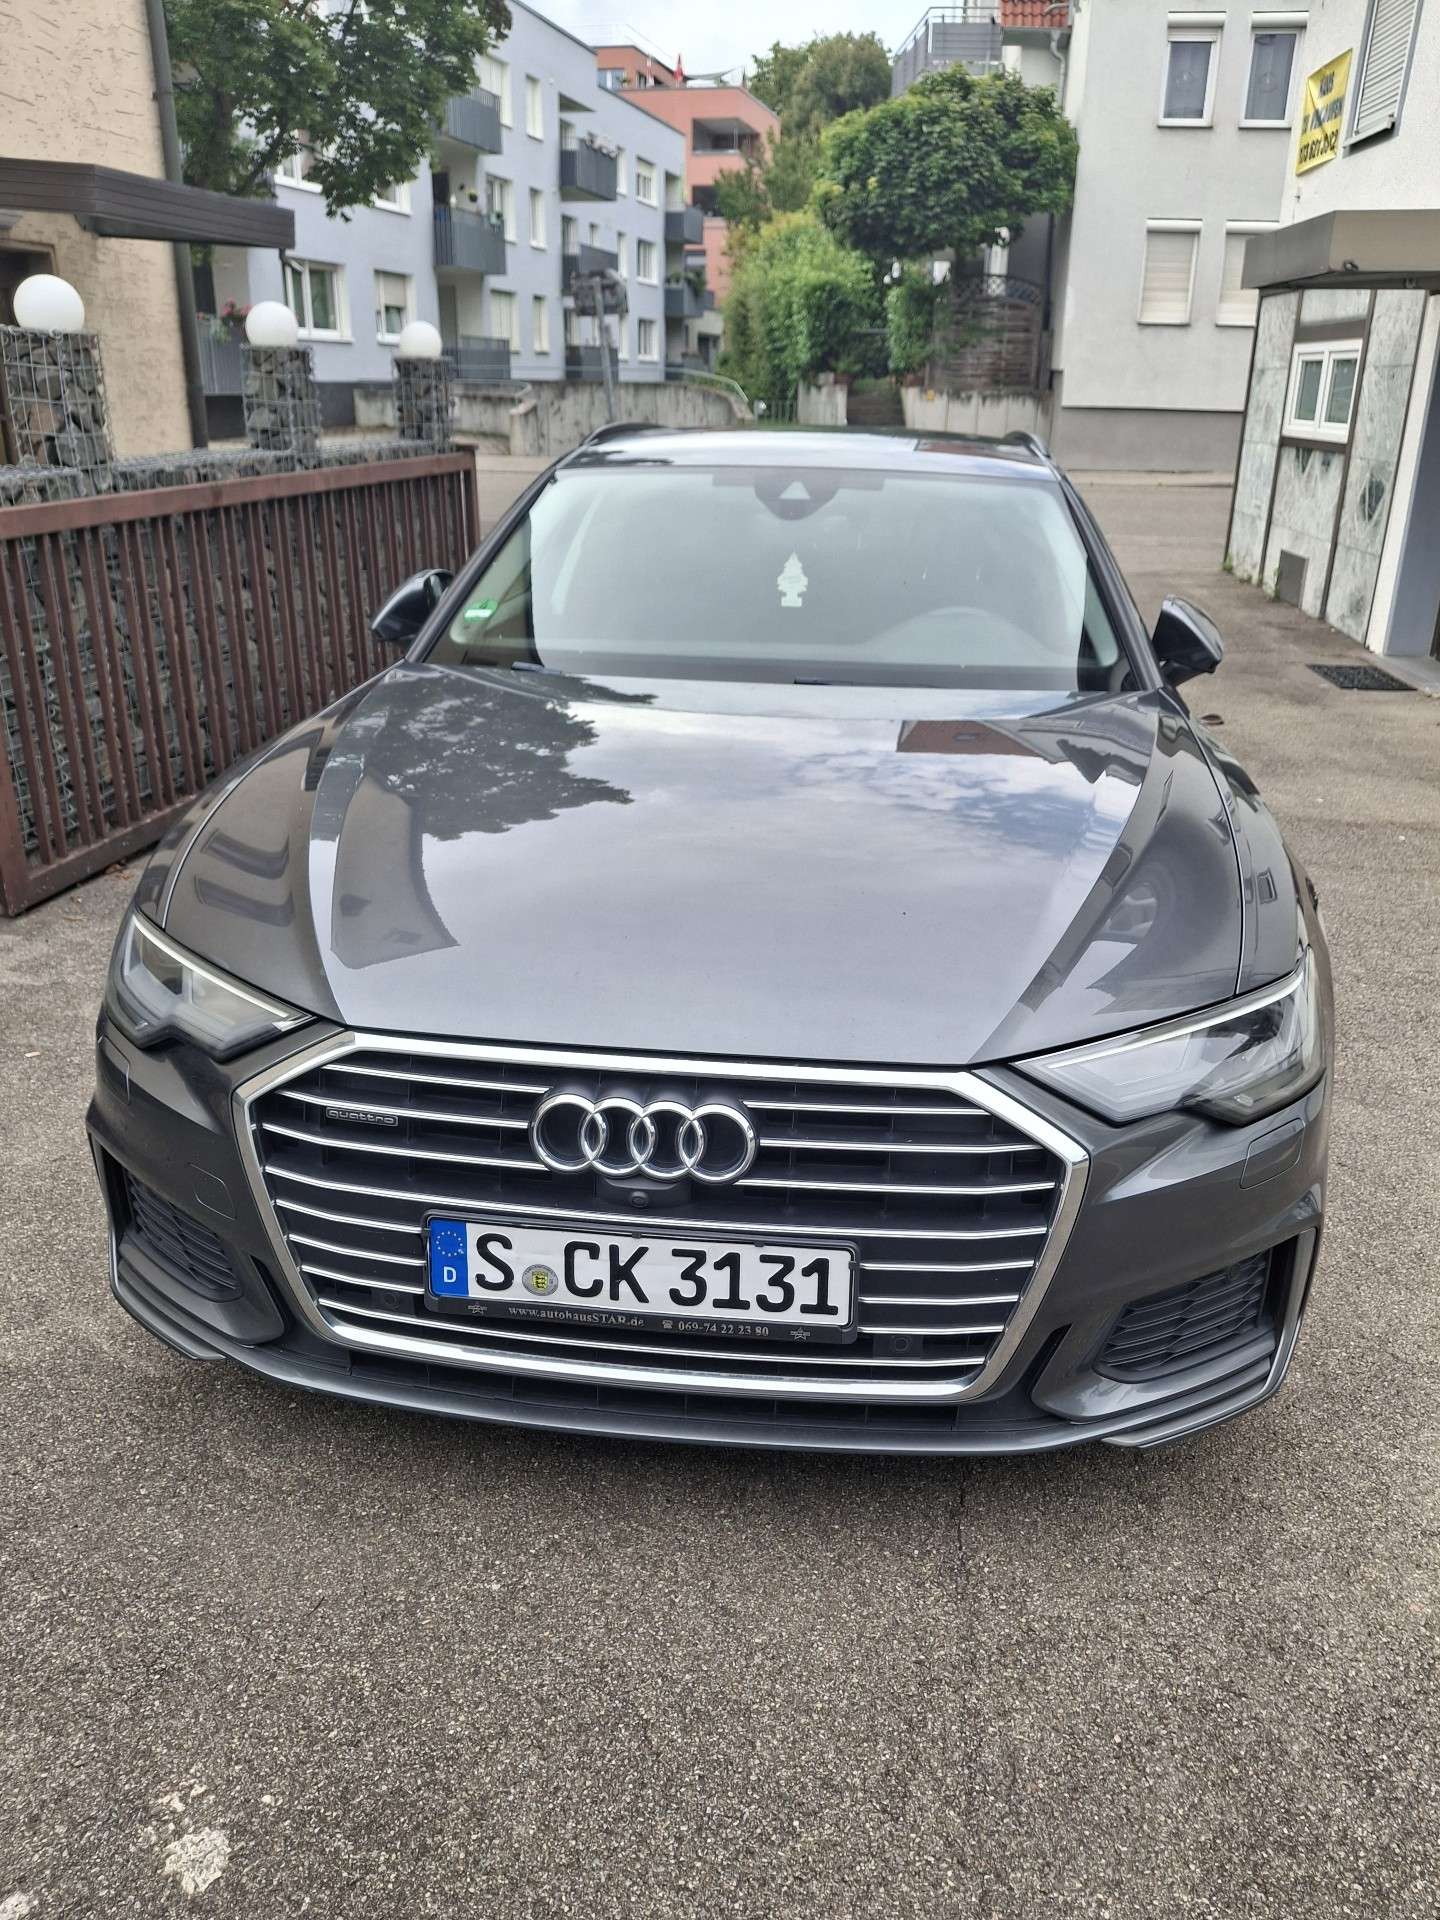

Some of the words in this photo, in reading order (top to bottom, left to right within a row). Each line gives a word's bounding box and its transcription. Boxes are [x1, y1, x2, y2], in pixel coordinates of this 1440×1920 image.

[328, 1110, 394, 1124] quattro
[443, 1267, 457, 1283] D
[475, 1233, 515, 1291] S
[564, 1240, 650, 1304] CK
[669, 1248, 839, 1316] 3131
[508, 1306, 645, 1327] www.autohausSTAR.de
[678, 1320, 717, 1334] 069-74
[721, 1324, 734, 1335] 22
[738, 1325, 751, 1336] 23
[754, 1326, 770, 1337] 80
